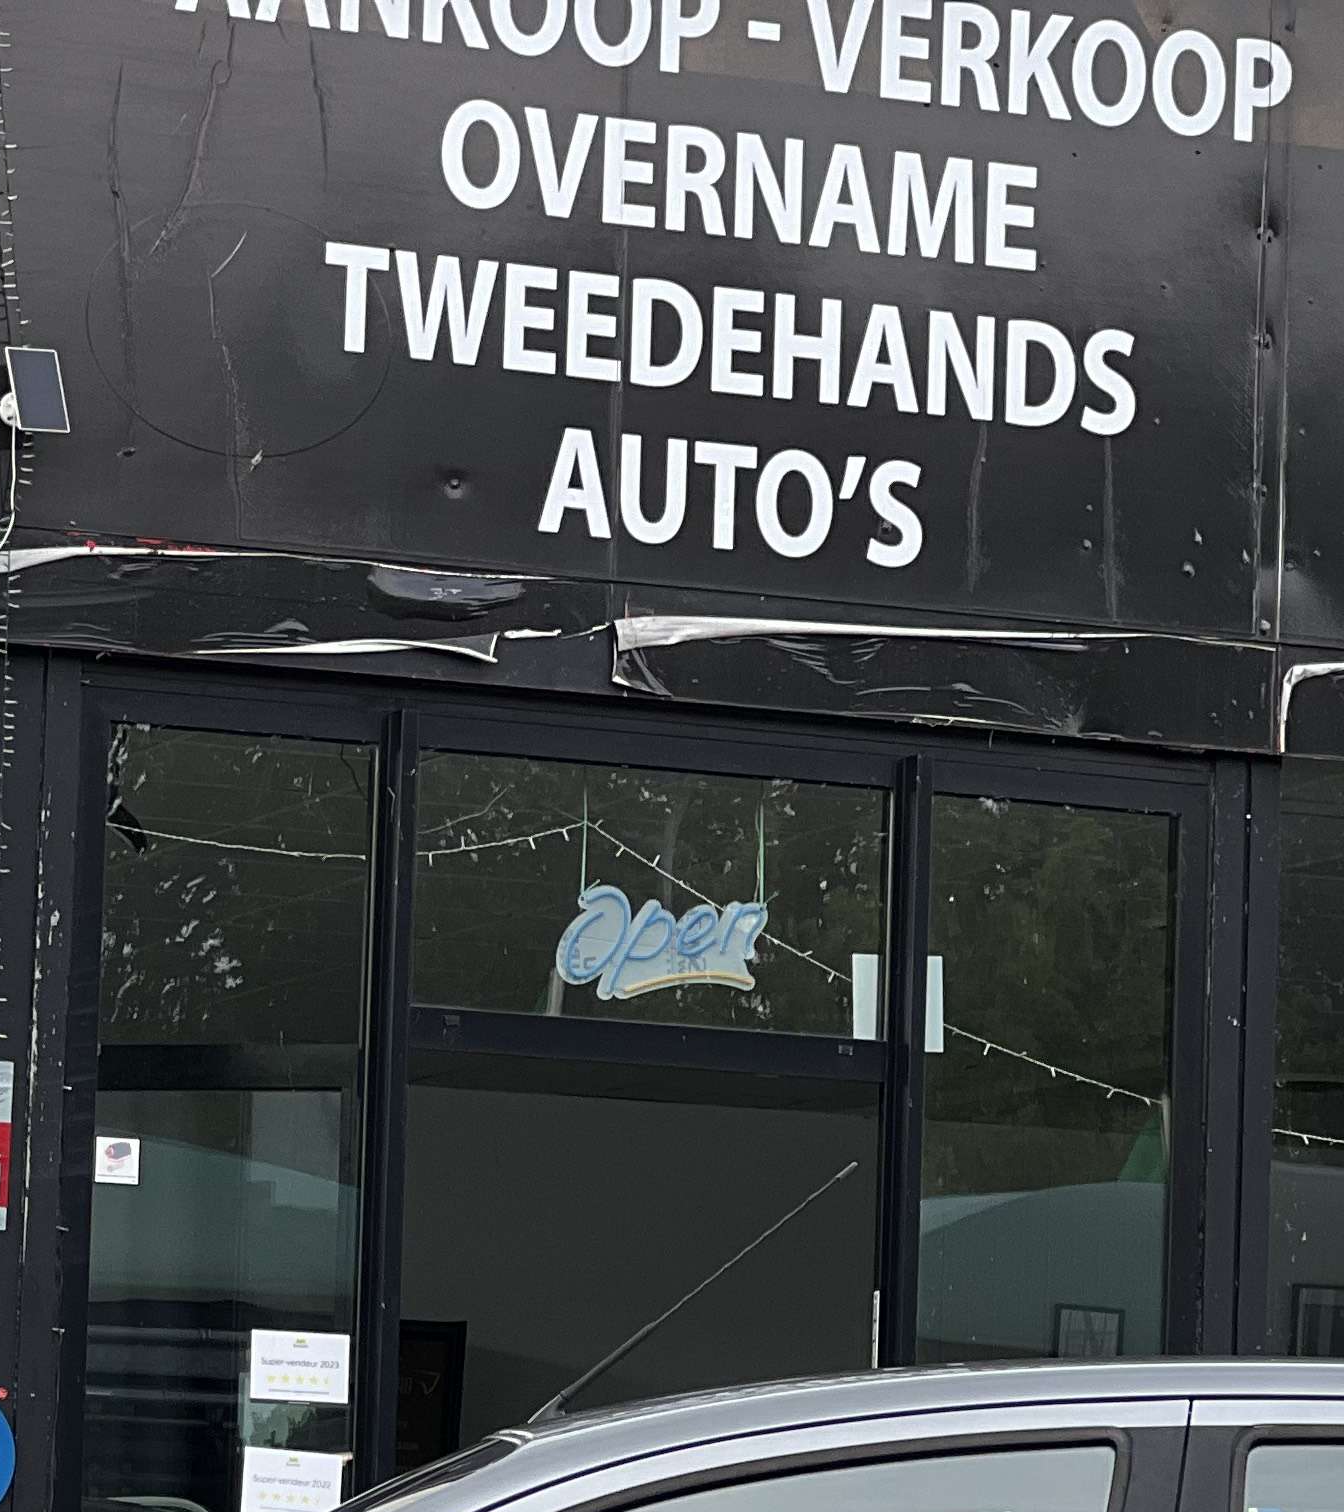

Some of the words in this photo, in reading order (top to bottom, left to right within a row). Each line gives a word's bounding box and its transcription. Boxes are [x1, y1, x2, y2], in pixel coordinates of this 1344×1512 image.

[802, 0, 1293, 143] VERKOOP
[442, 100, 1039, 272] OVERNAME
[325, 241, 1136, 437] TWEEDEHANDS
[538, 427, 922, 568] AUTO'S
[562, 886, 766, 996] Open
